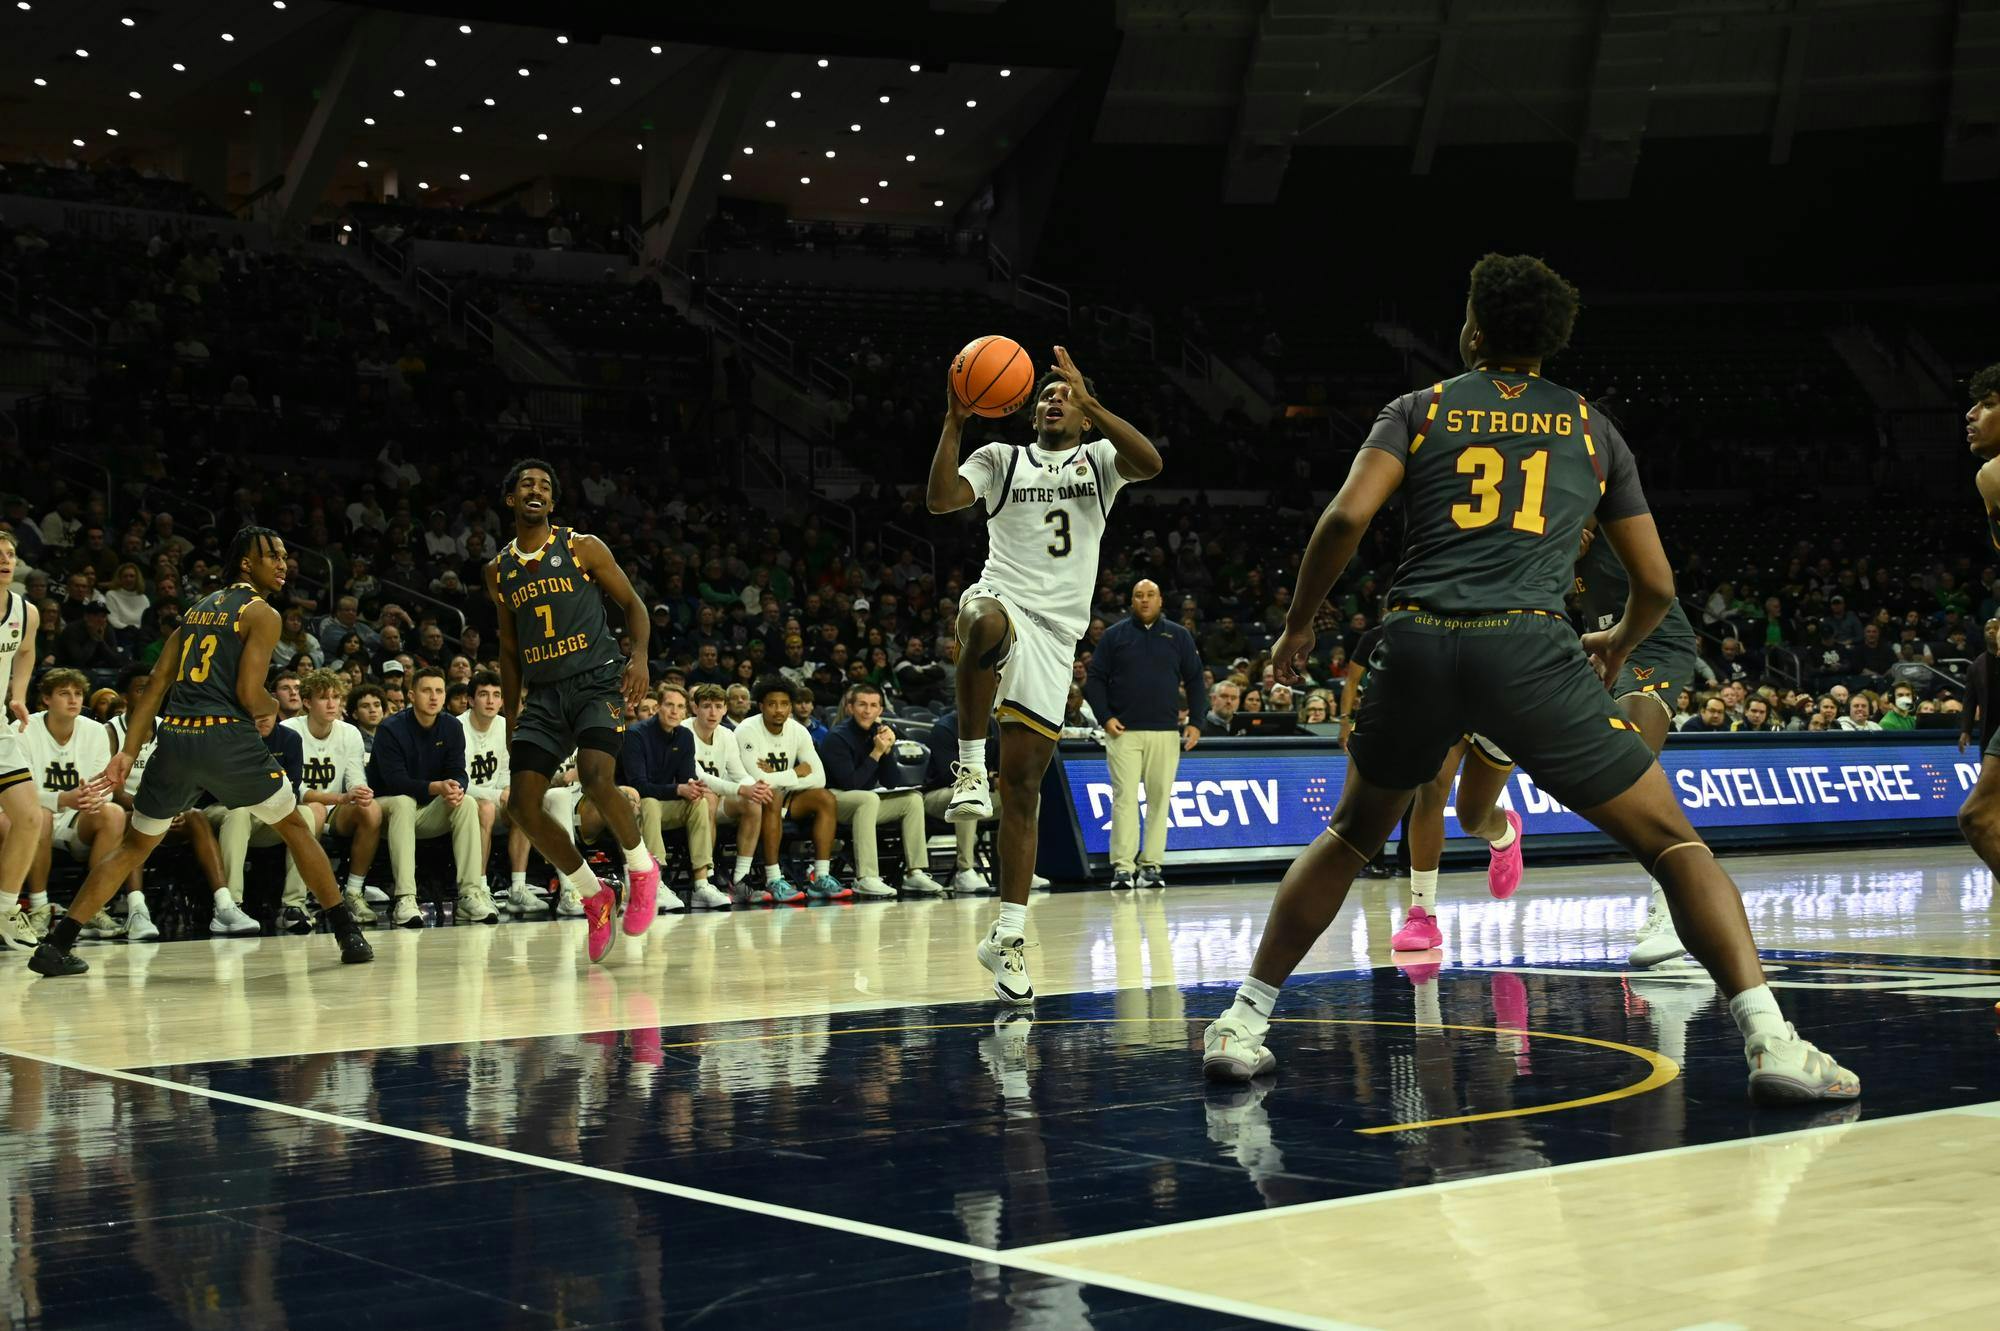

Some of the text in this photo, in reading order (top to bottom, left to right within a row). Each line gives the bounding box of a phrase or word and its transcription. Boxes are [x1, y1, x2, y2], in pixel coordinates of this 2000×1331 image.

[1446, 409, 1573, 436] STRONG
[1012, 481, 1096, 503] NOTRE DAME
[1450, 445, 1549, 535] 31
[1044, 508, 1072, 558] 3
[511, 577, 574, 608] BOSTON
[186, 611, 215, 625] HAND
[534, 604, 556, 638] 7
[0, 641, 19, 653] AME
[176, 633, 218, 683] 13
[524, 633, 588, 664] COLLEGE
[43, 761, 80, 793] ND
[301, 757, 336, 790] ND
[471, 751, 498, 785] ND
[1675, 763, 1921, 809] SATELLITE-FREE
